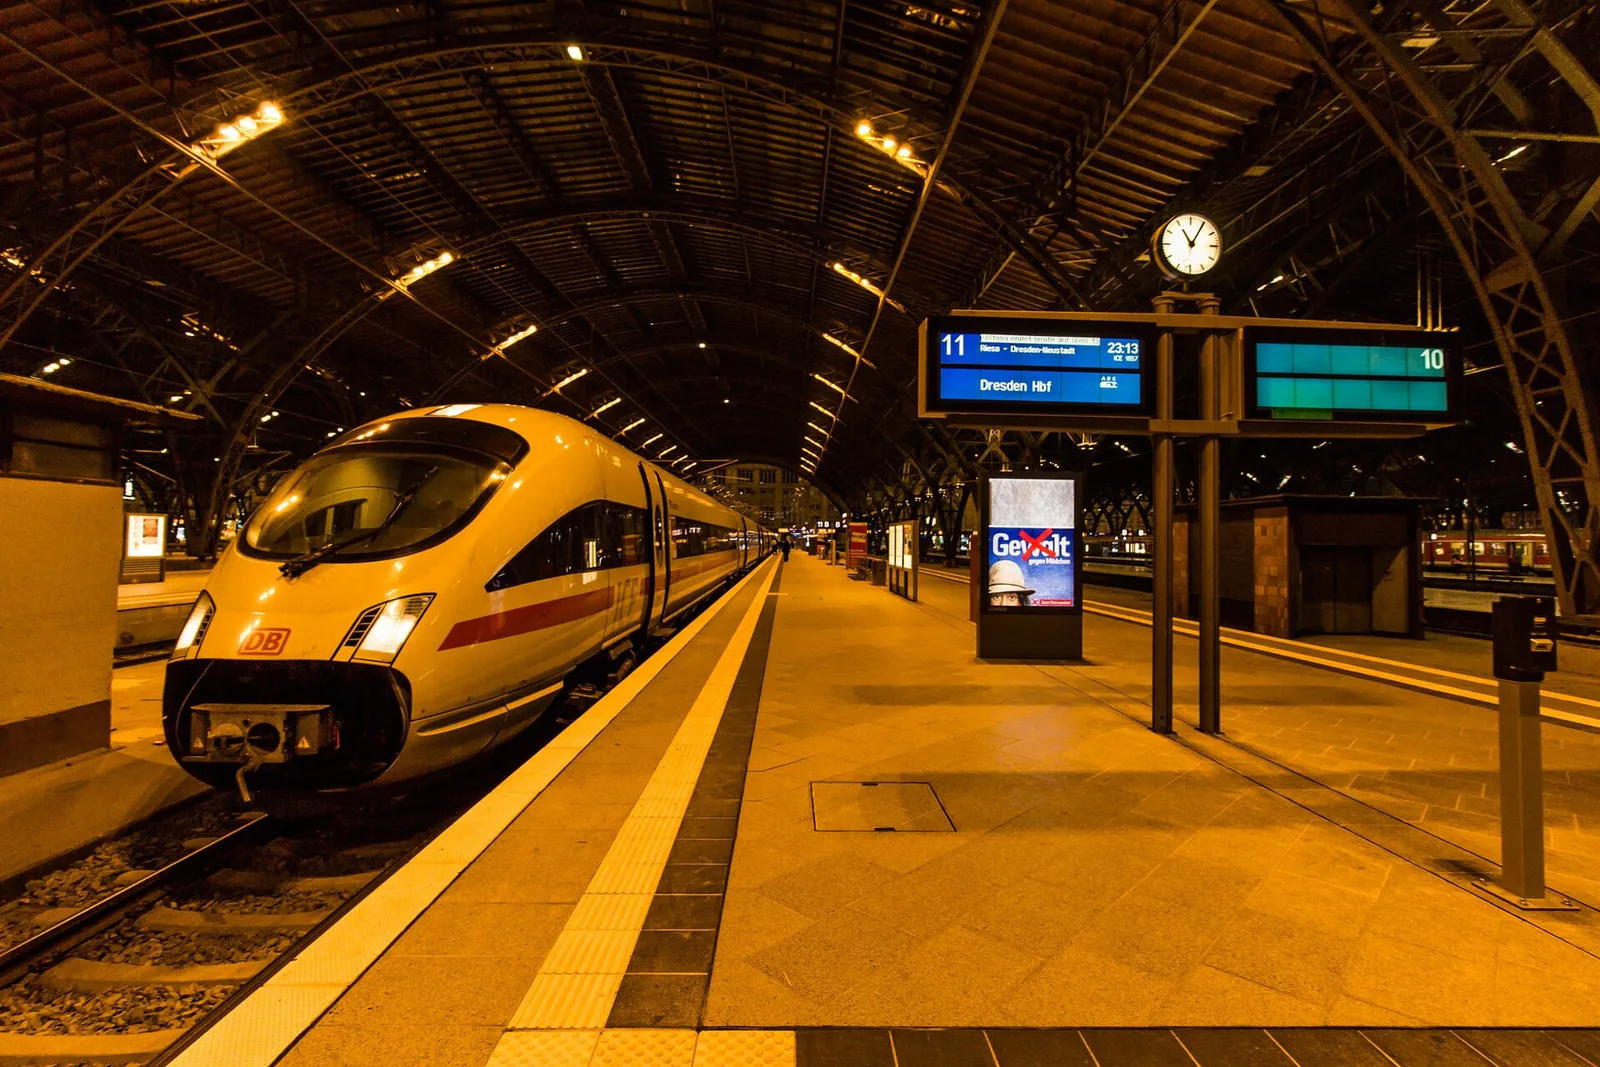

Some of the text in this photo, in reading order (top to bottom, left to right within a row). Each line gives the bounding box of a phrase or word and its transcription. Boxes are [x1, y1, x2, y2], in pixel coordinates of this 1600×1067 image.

[941, 334, 964, 356] 11
[980, 344, 1000, 352] Riesa
[1010, 345, 1075, 355] Dresden-Neustadt
[1107, 342, 1139, 355] 23:13
[1420, 349, 1444, 370] 10
[980, 378, 1052, 393] Dresden Hbf
[243, 631, 283, 651] DB
